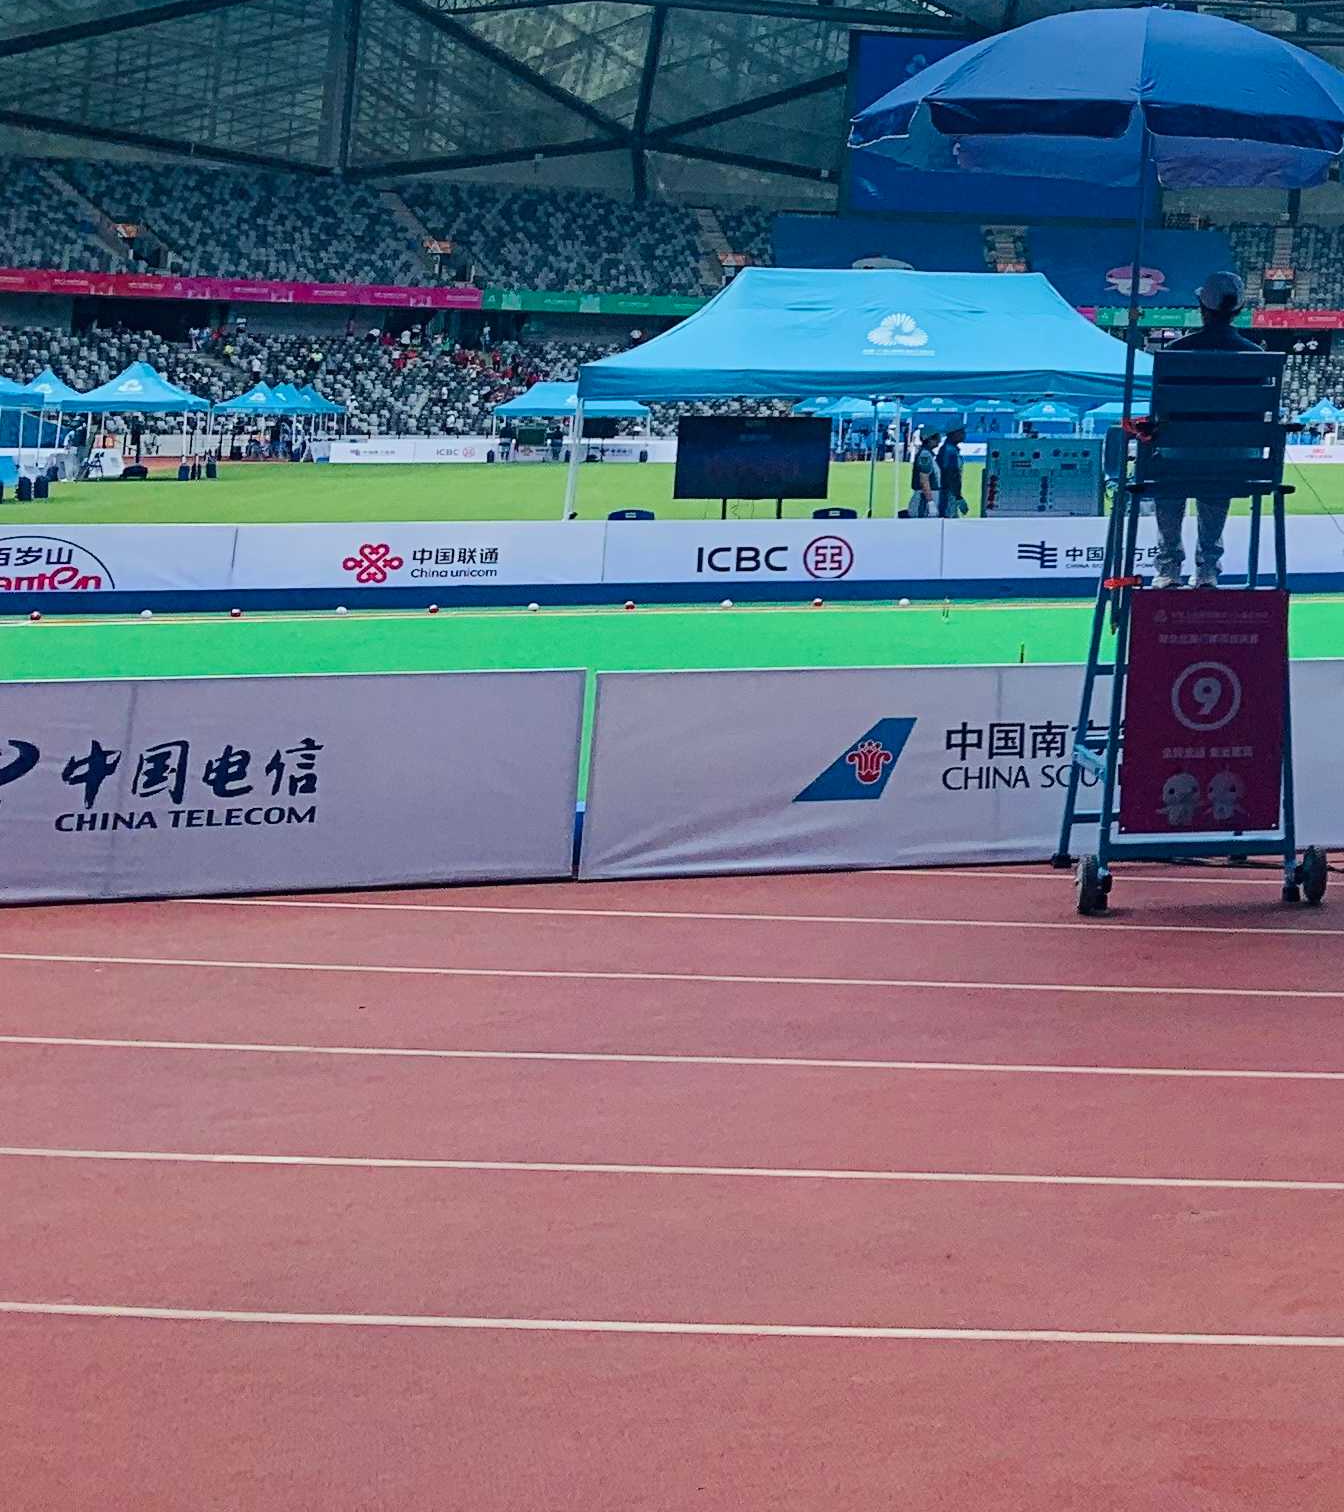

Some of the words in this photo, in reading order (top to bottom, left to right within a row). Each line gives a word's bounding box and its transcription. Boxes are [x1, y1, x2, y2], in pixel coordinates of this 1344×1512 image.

[412, 547, 499, 565] 中国联通
[696, 545, 789, 573] ICBC
[410, 568, 449, 579] China
[450, 568, 498, 578] unicom
[1192, 676, 1223, 716] 9
[61, 737, 324, 810] 中国电信
[941, 765, 1030, 791] CHINA
[54, 811, 158, 832] CHINA
[168, 805, 317, 829] TELECOM
